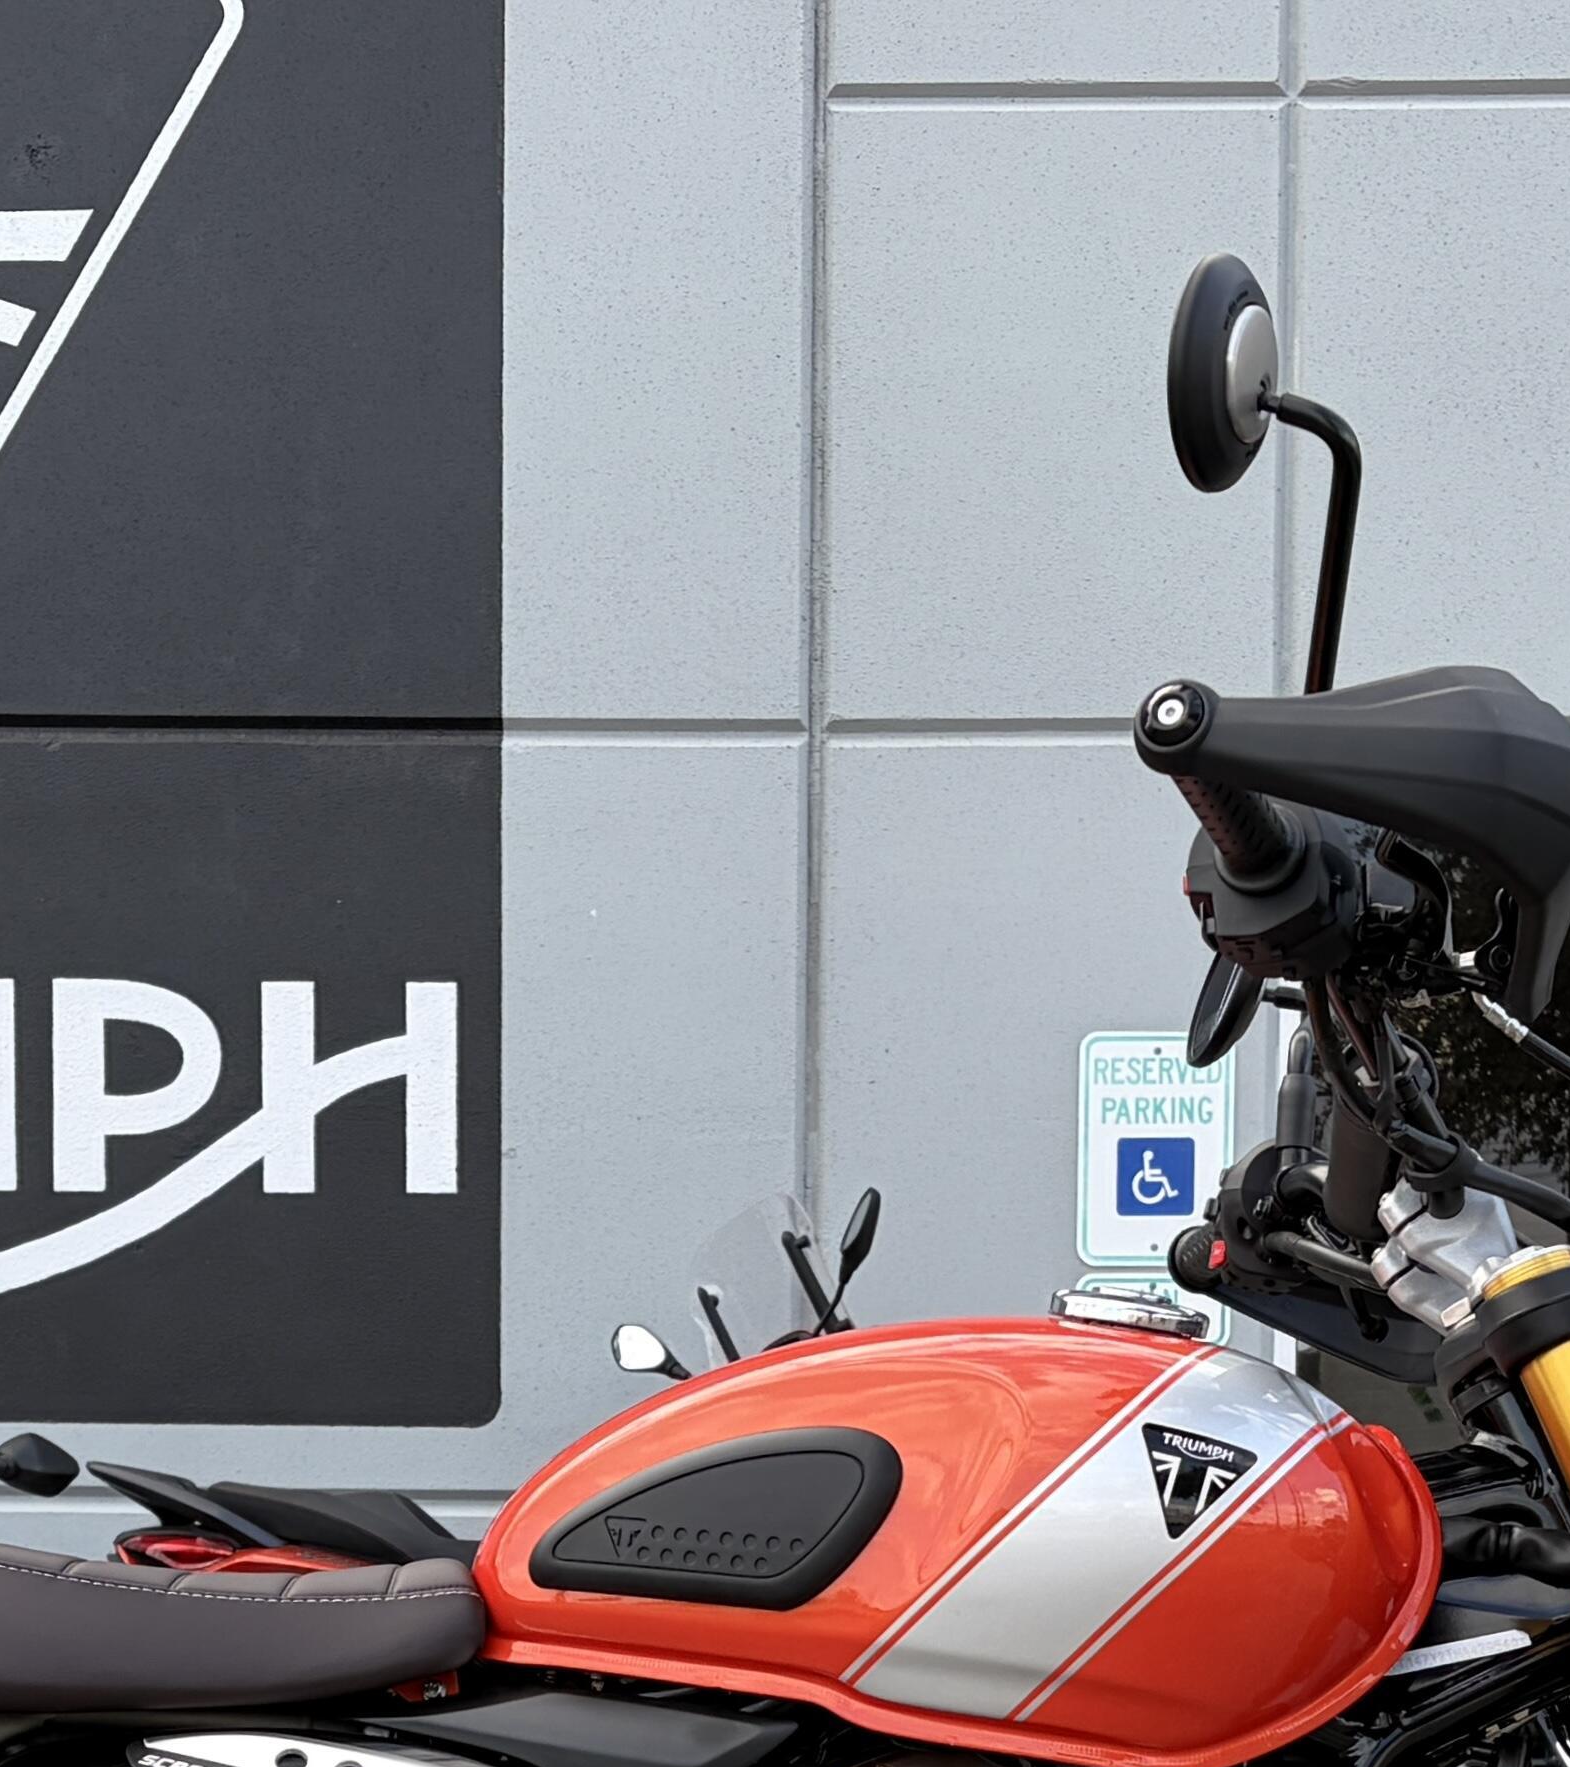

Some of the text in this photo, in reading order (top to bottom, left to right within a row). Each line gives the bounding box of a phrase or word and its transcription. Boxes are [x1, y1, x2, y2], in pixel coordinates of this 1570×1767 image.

[1093, 1058, 1222, 1085] RESERVED
[1101, 1097, 1213, 1125] PARKING
[1163, 1432, 1235, 1463] TRIUMPH
